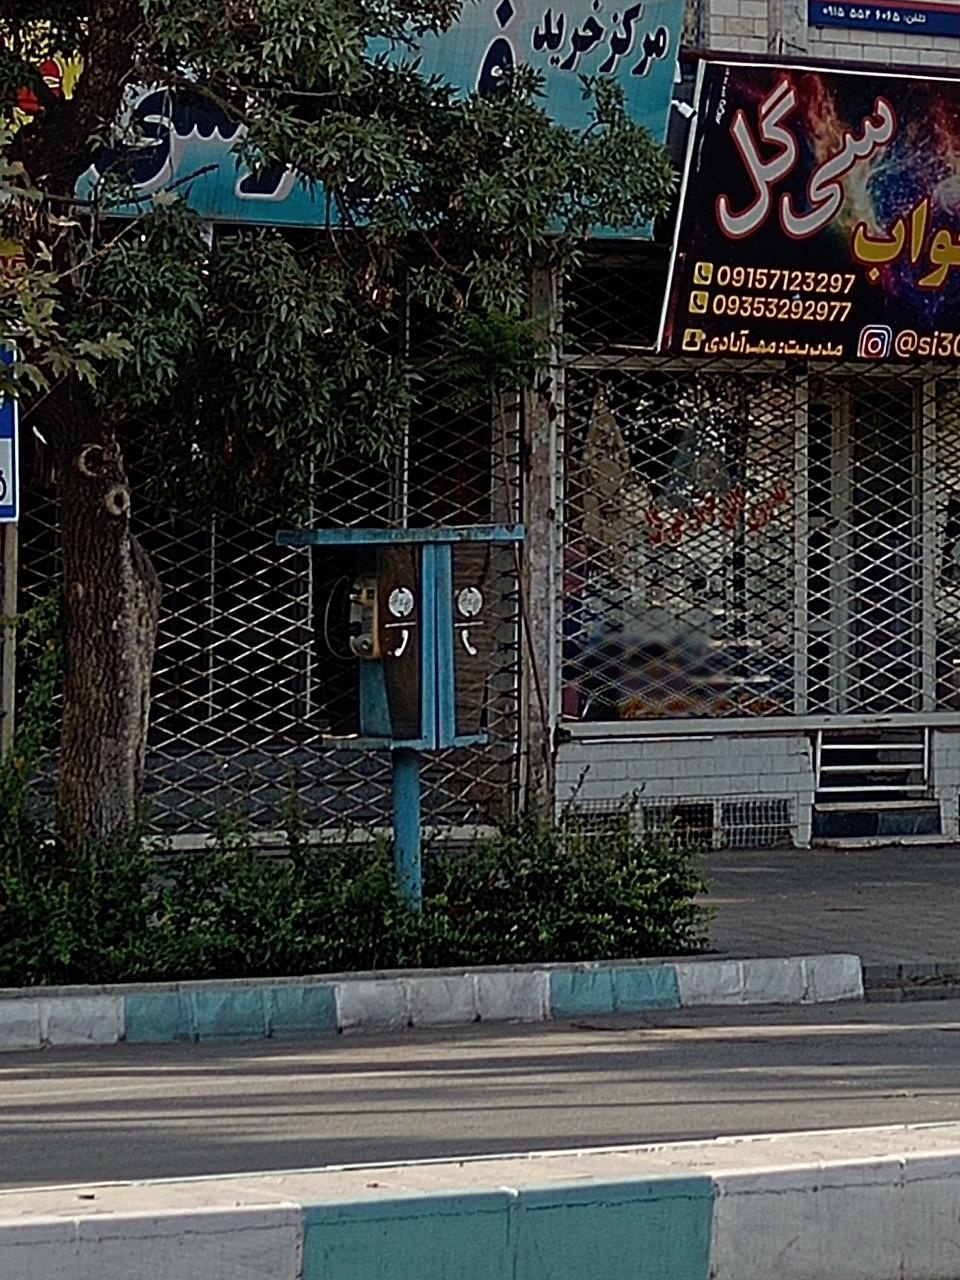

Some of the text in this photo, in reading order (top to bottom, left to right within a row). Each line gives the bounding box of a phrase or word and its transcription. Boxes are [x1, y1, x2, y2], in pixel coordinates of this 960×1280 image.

[598, 2, 668, 76] مرکز
[717, 77, 797, 237] گل
[716, 265, 856, 294] 09157123297
[712, 293, 852, 322] 09353292977
